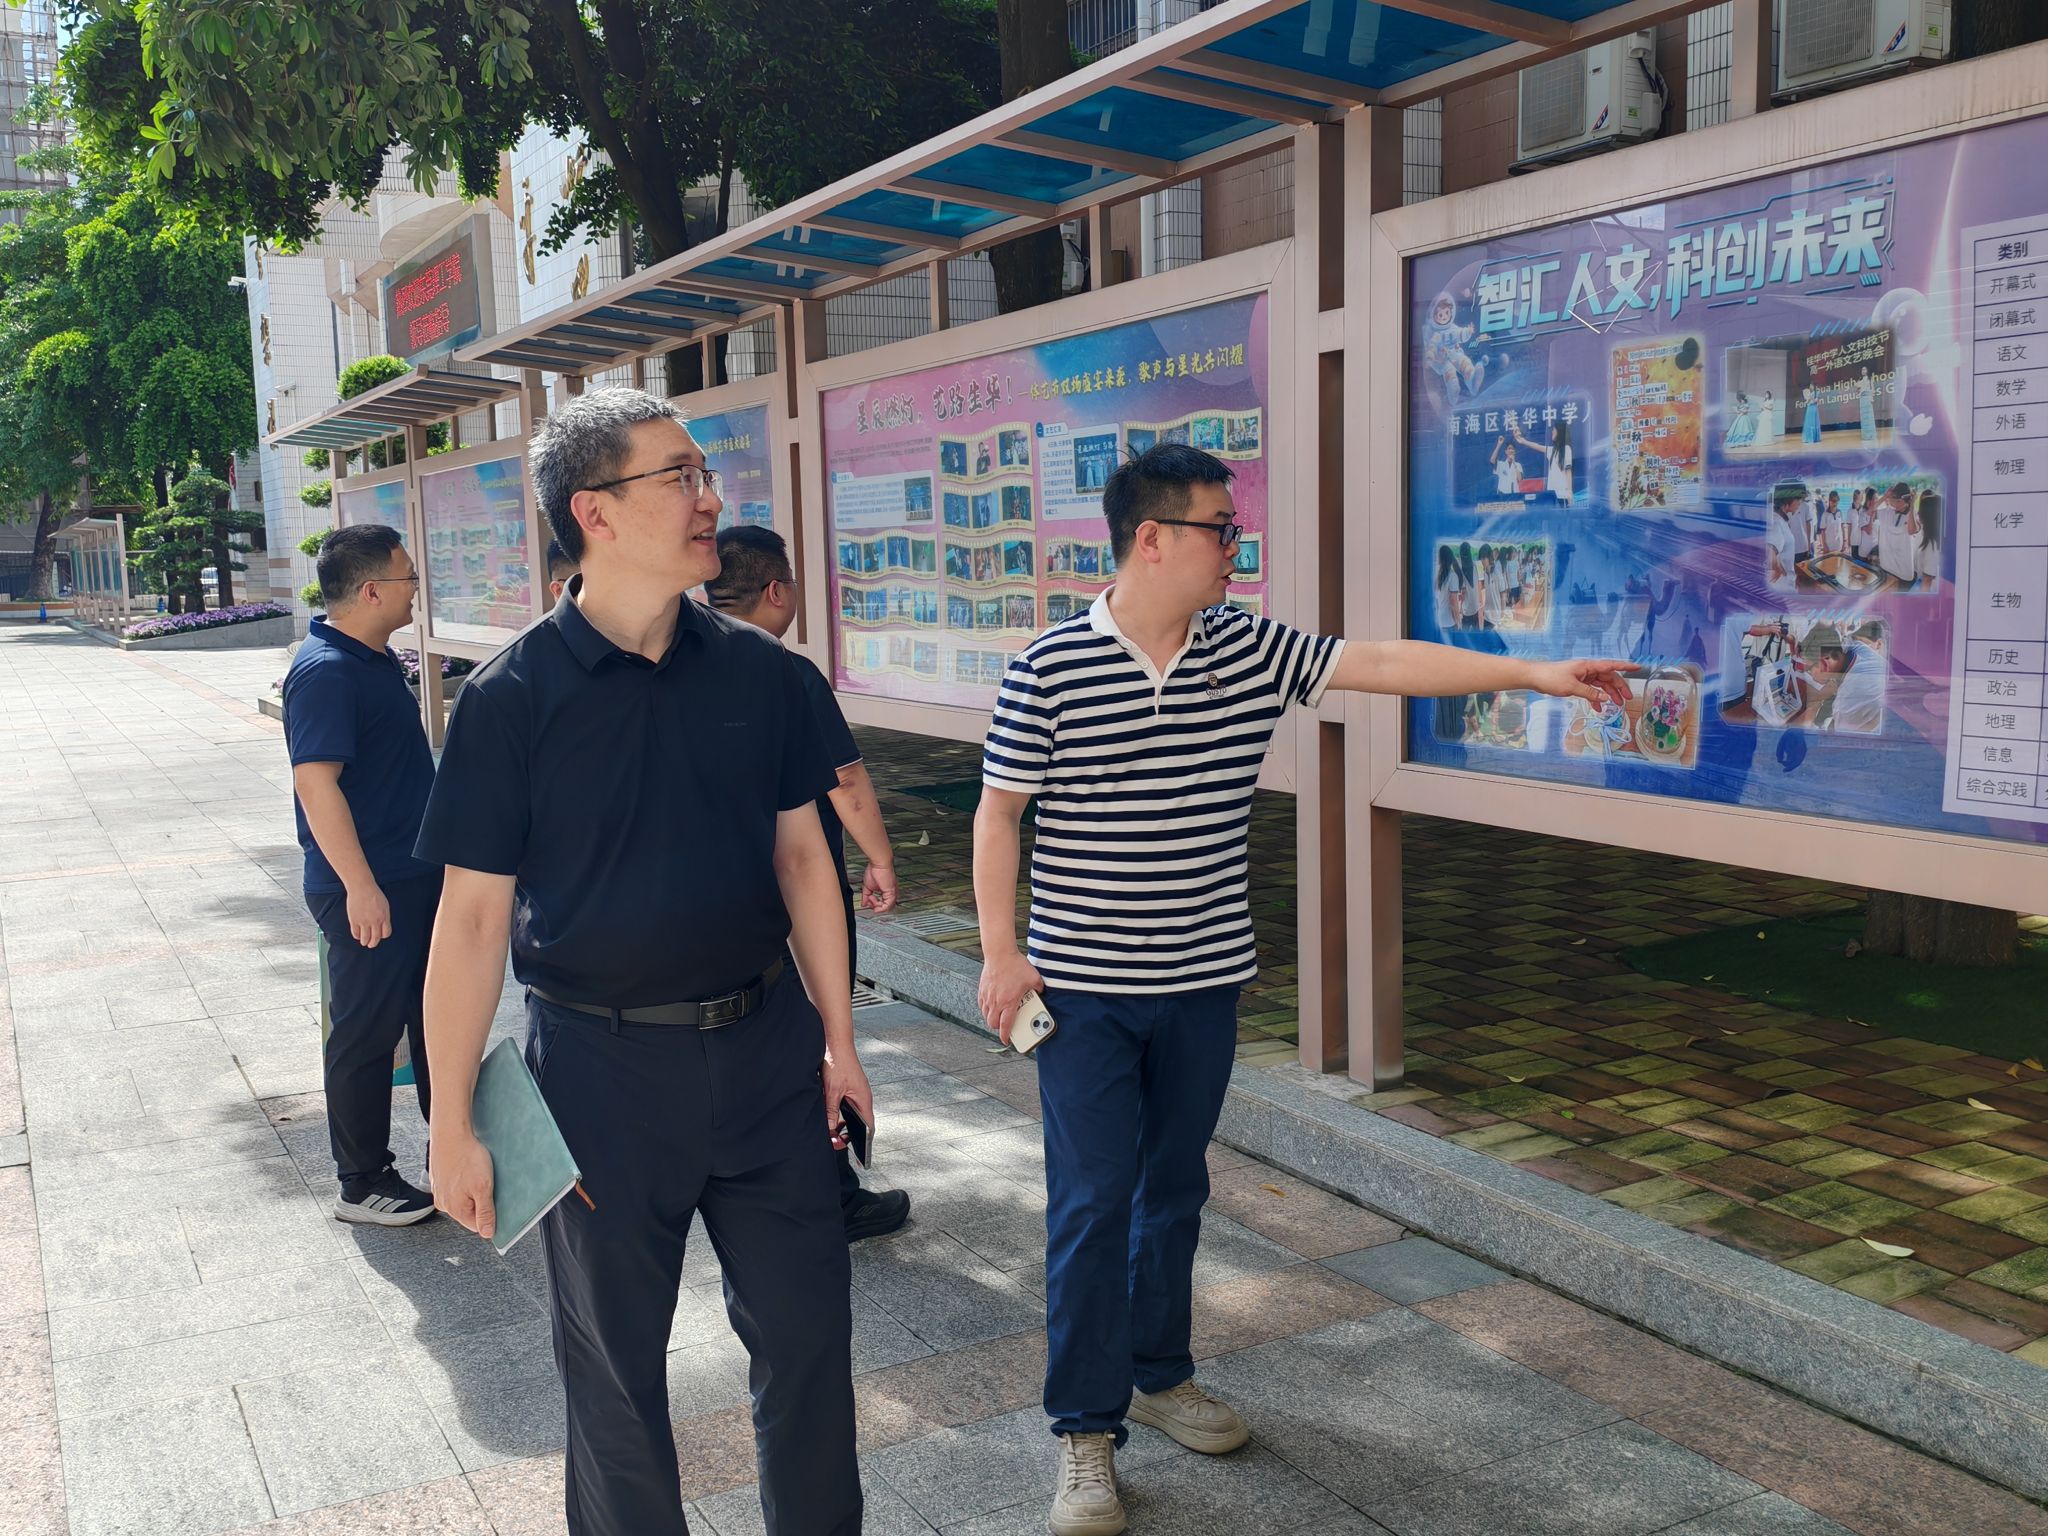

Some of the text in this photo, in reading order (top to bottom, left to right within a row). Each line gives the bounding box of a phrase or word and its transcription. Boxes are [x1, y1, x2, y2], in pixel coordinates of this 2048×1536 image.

[1998, 240, 2028, 260] 类别
[1477, 196, 1887, 333] 智汇人文，科创未来
[1990, 273, 2036, 294] 开幕式
[1989, 308, 2036, 329] 闭幕式
[1806, 330, 1890, 366] 桂华中学人文科技节
[1997, 344, 2027, 361] 语文
[1996, 378, 2026, 396] 数学
[1995, 413, 2026, 430] 外语
[1994, 459, 2025, 475] 物理
[1994, 512, 2024, 528] 化学
[1991, 592, 2022, 608] 生物
[1988, 649, 2019, 665] 历史
[1987, 680, 2017, 696] 政治
[1985, 713, 2016, 729] 地理
[1984, 746, 2013, 762] 信息
[1966, 777, 2028, 798] 综合实践
